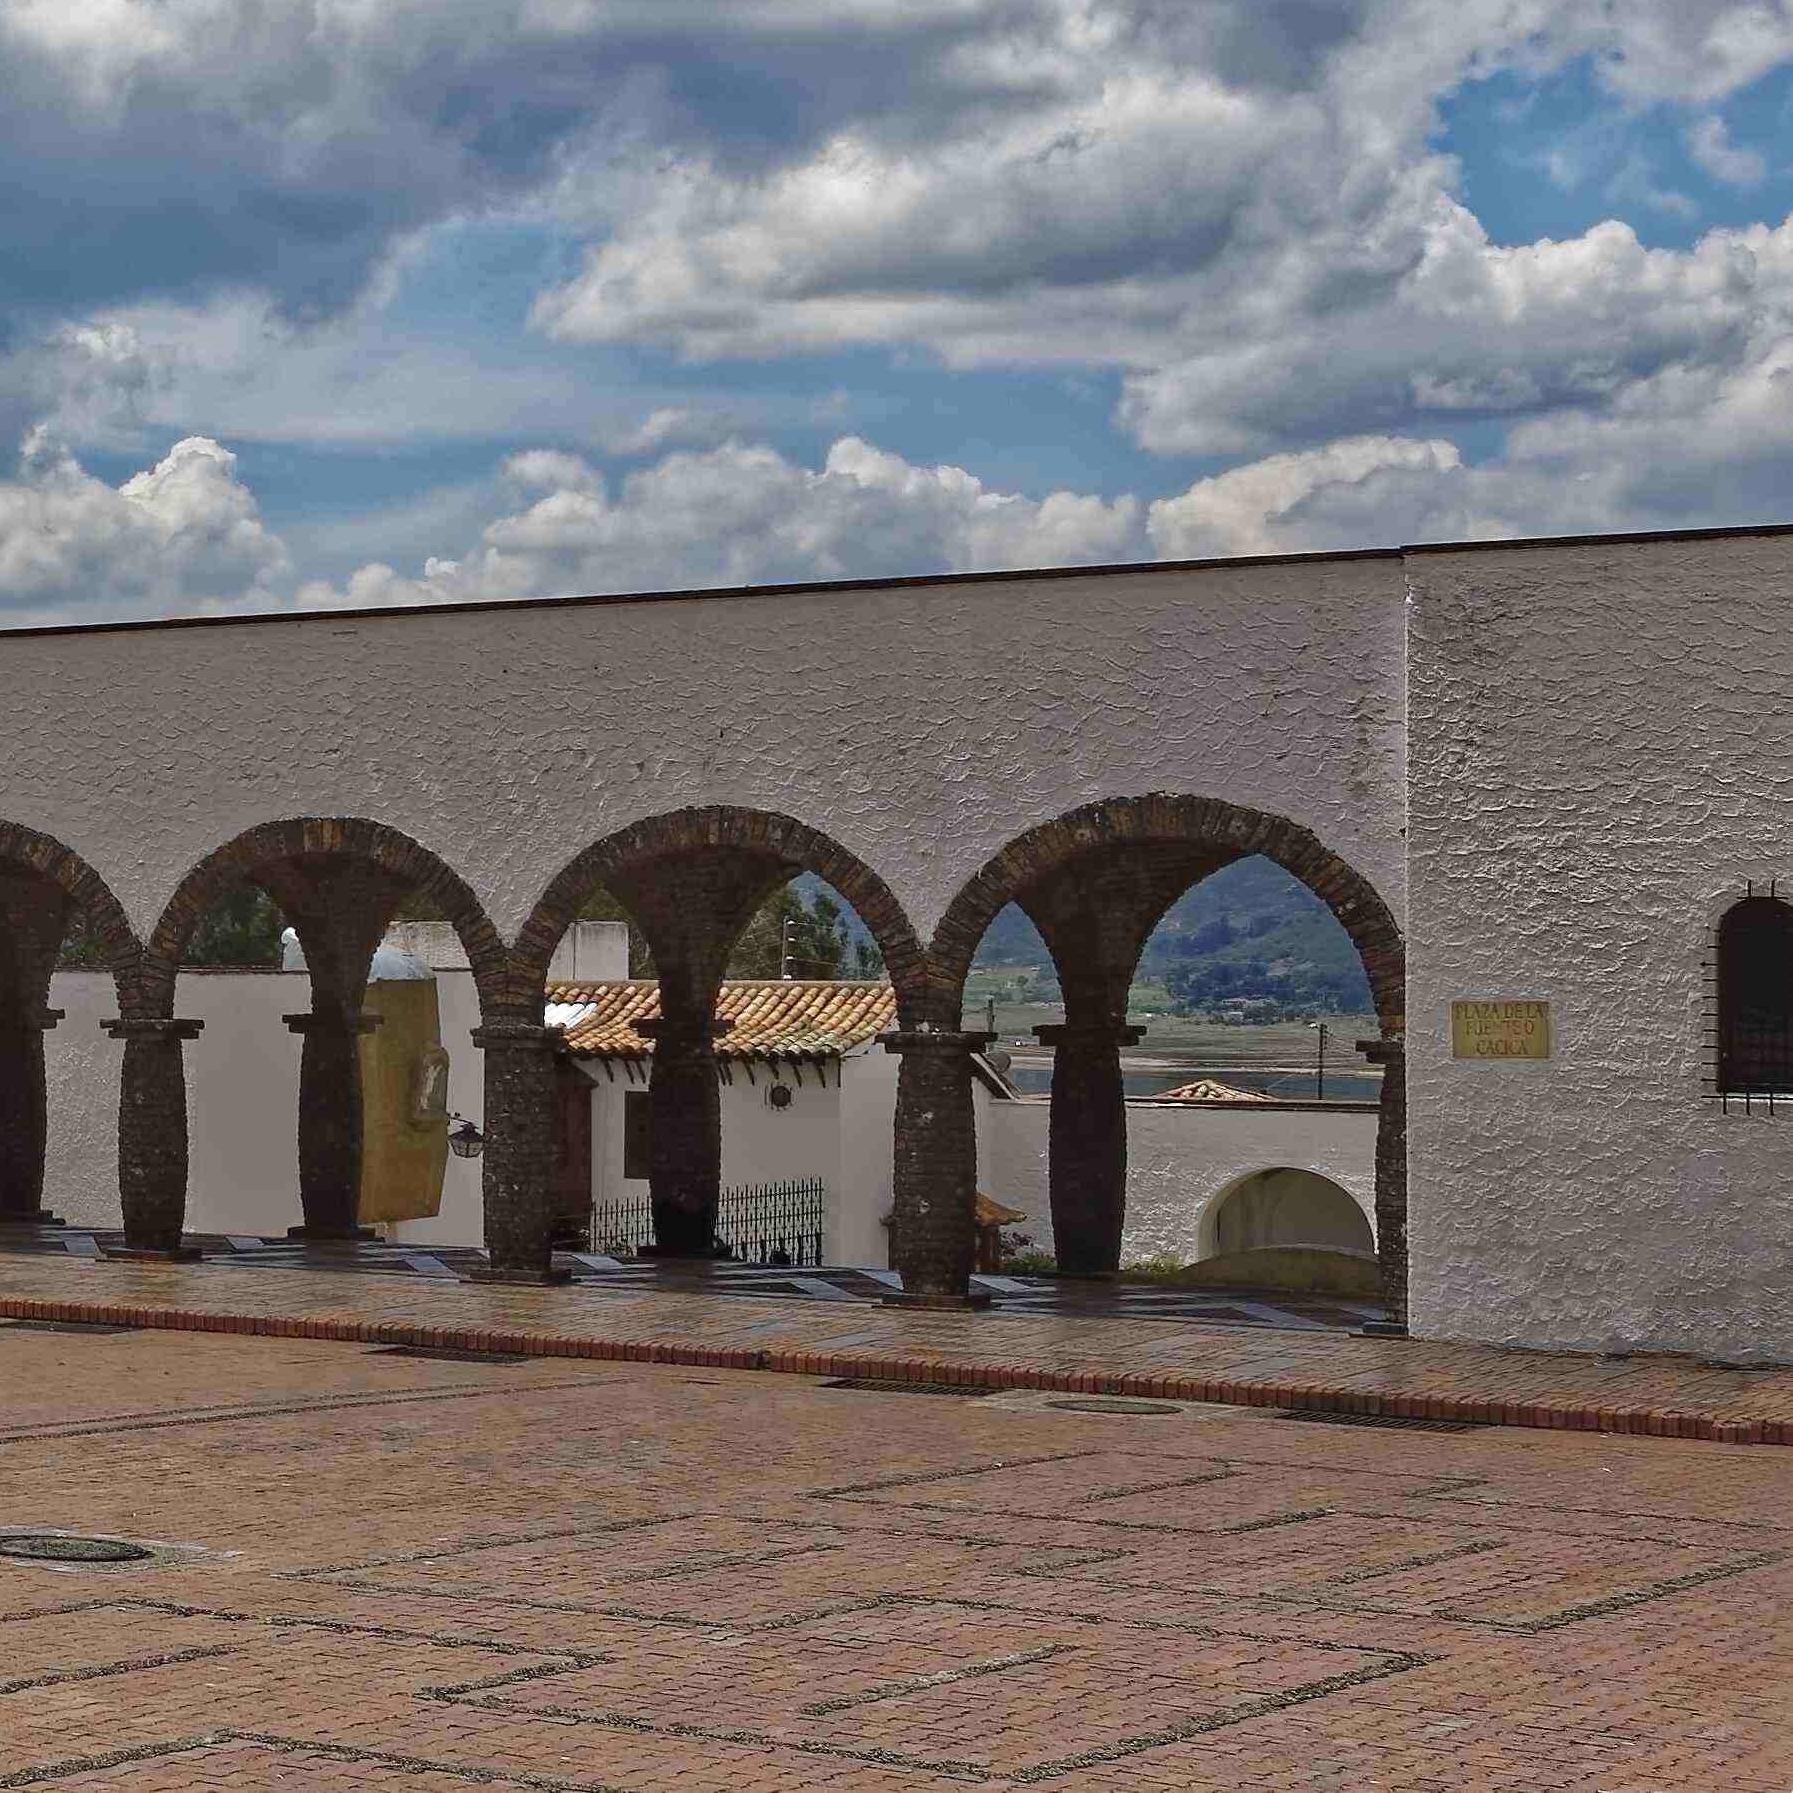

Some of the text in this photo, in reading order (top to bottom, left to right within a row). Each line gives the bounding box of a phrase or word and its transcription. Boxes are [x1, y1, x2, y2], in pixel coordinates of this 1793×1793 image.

[1455, 1004, 1544, 1020] PLAZA DE LA
[1465, 1020, 1521, 1036] FUETE
[1475, 1040, 1529, 1056] CACICA
